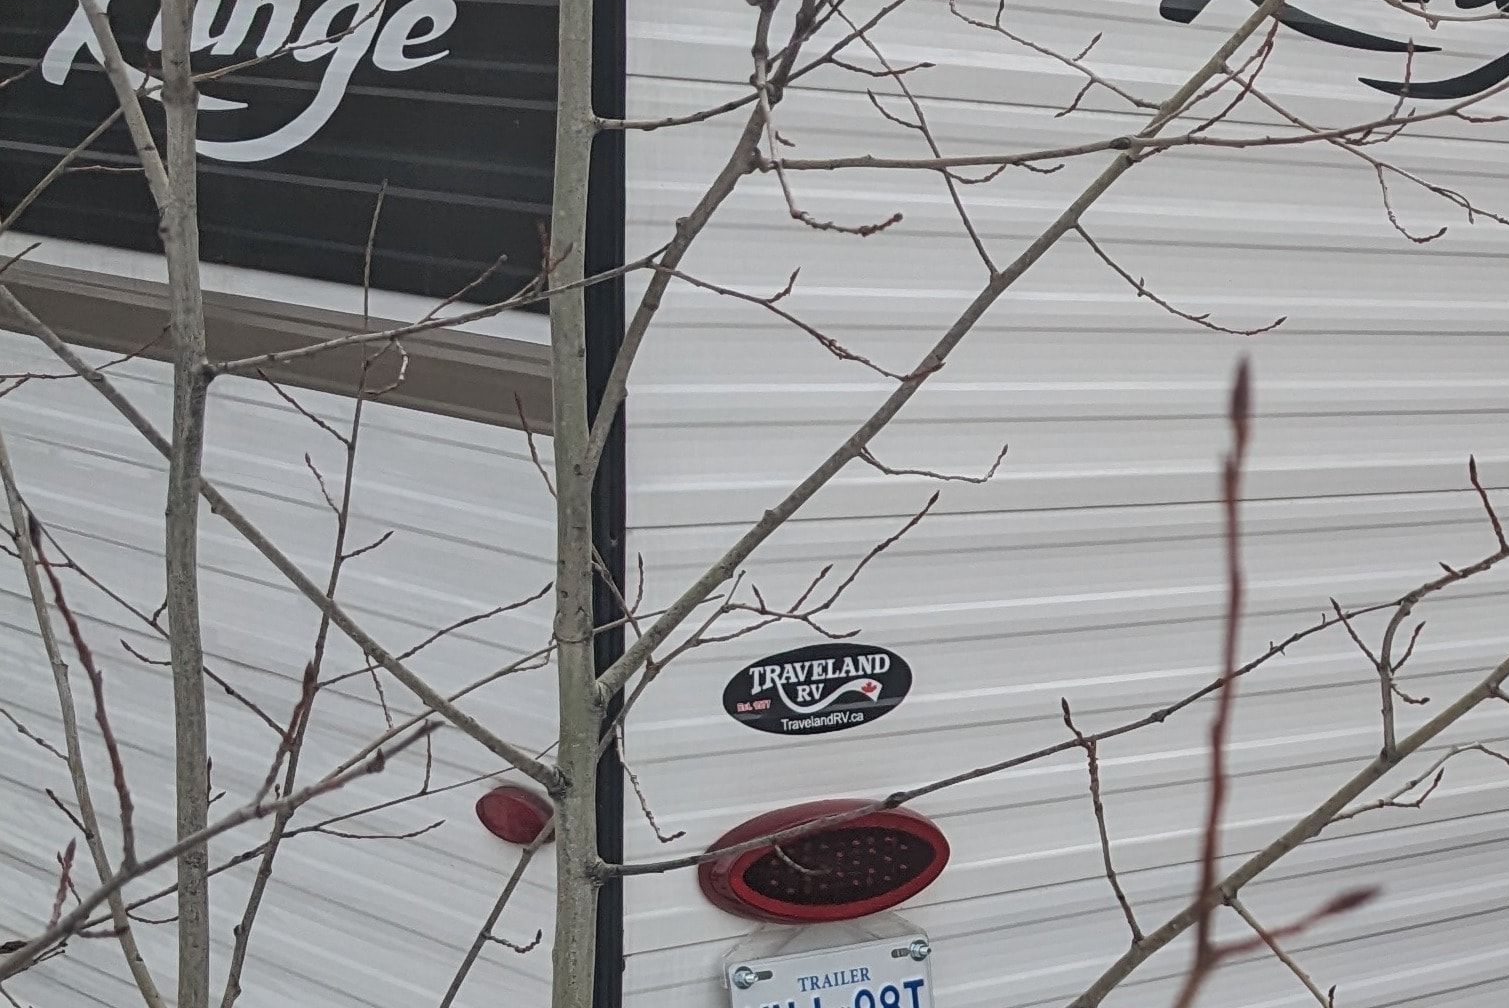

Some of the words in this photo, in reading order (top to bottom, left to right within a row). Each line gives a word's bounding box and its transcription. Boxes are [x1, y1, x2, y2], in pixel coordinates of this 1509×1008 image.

[749, 653, 891, 696] TRAVELAND
[796, 683, 824, 703] RV
[781, 711, 864, 732] TravelandRV.ca
[797, 967, 871, 993] TRAILER
